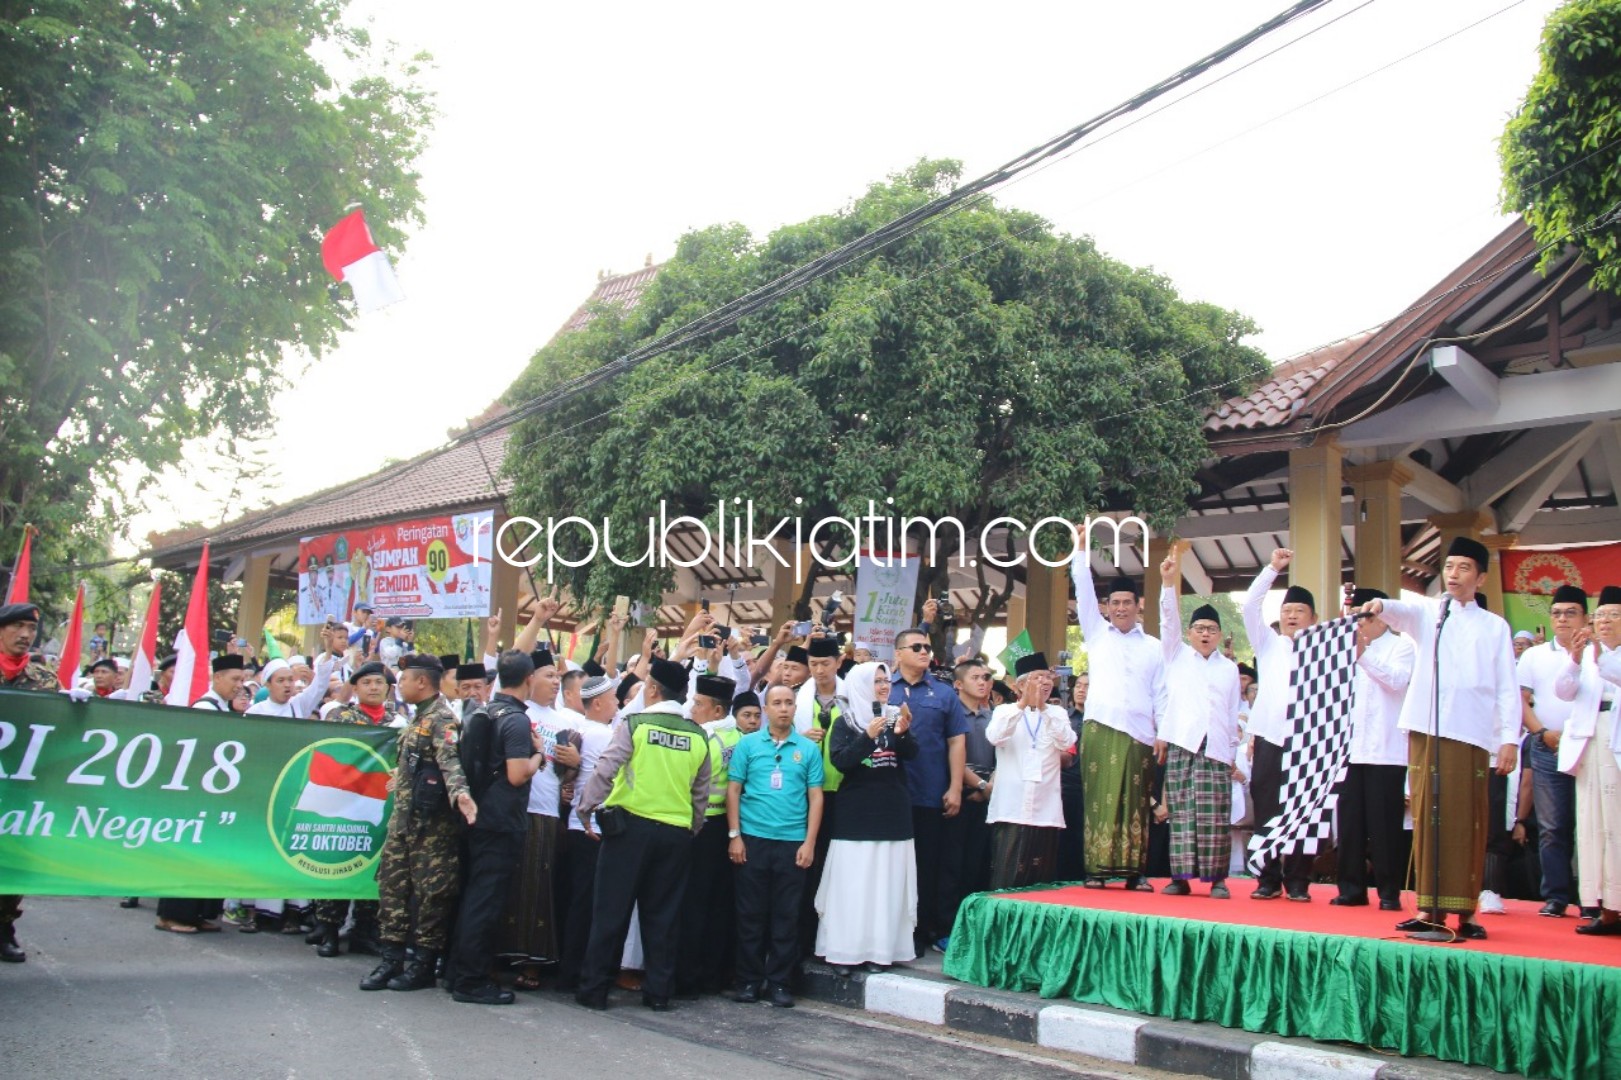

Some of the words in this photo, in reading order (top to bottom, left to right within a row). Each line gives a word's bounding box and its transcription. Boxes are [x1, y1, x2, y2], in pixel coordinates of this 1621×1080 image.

[397, 524, 448, 544] Peringatan
[373, 546, 419, 569] SUMPAH
[429, 549, 446, 573] 90
[648, 729, 691, 751] POLISI
[66, 728, 246, 794] 2018
[66, 806, 207, 849] Negeri
[312, 823, 335, 833] SANTRI
[336, 824, 369, 834] NASIONAL
[290, 833, 309, 850] 22
[311, 834, 373, 851] OKTOBER
